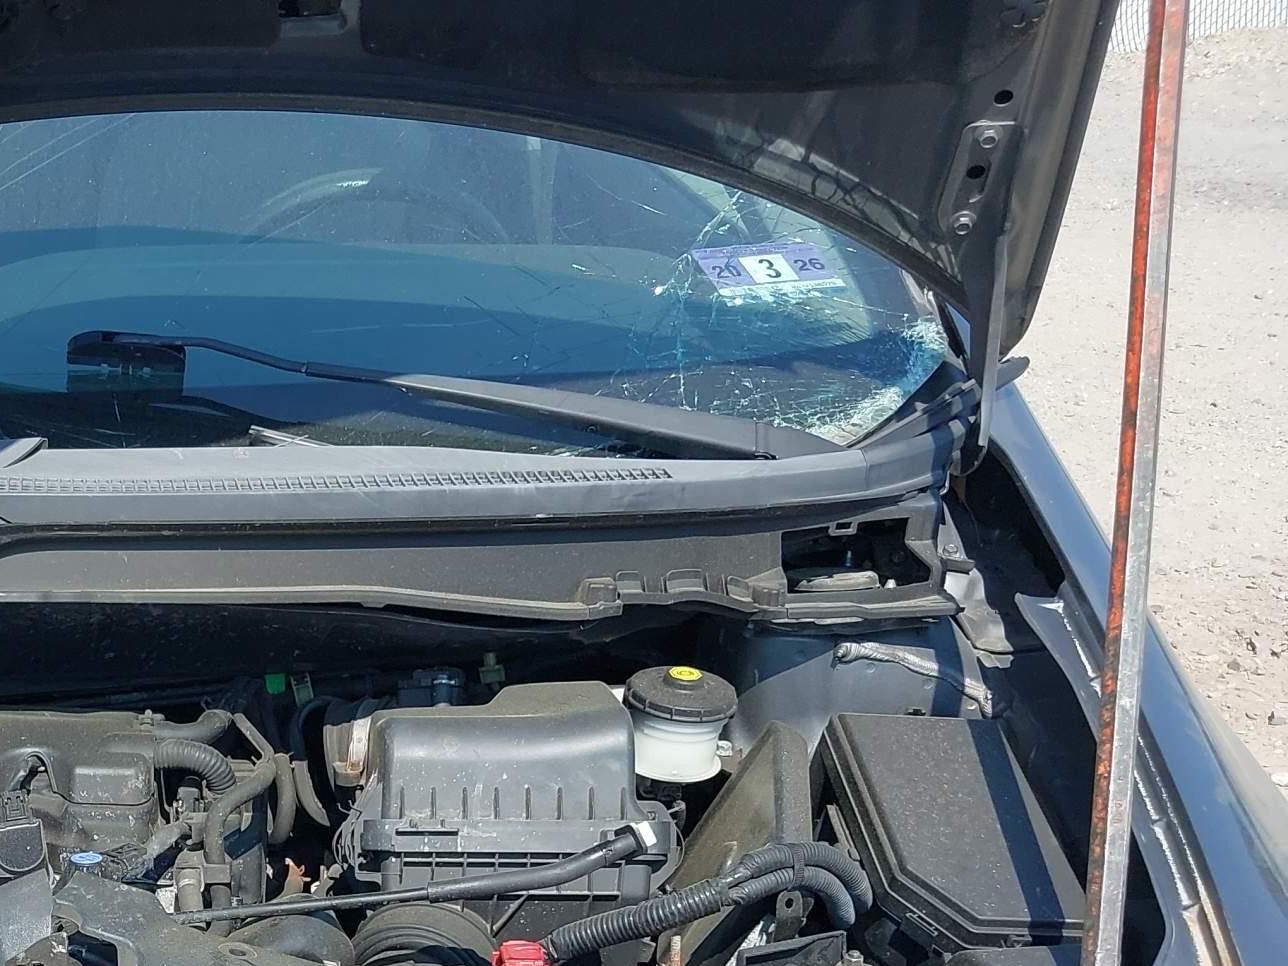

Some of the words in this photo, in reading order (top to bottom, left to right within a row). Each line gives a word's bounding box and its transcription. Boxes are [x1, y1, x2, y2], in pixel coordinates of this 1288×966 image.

[712, 264, 741, 279] 20
[758, 258, 782, 279] 3
[793, 257, 825, 272] 26
